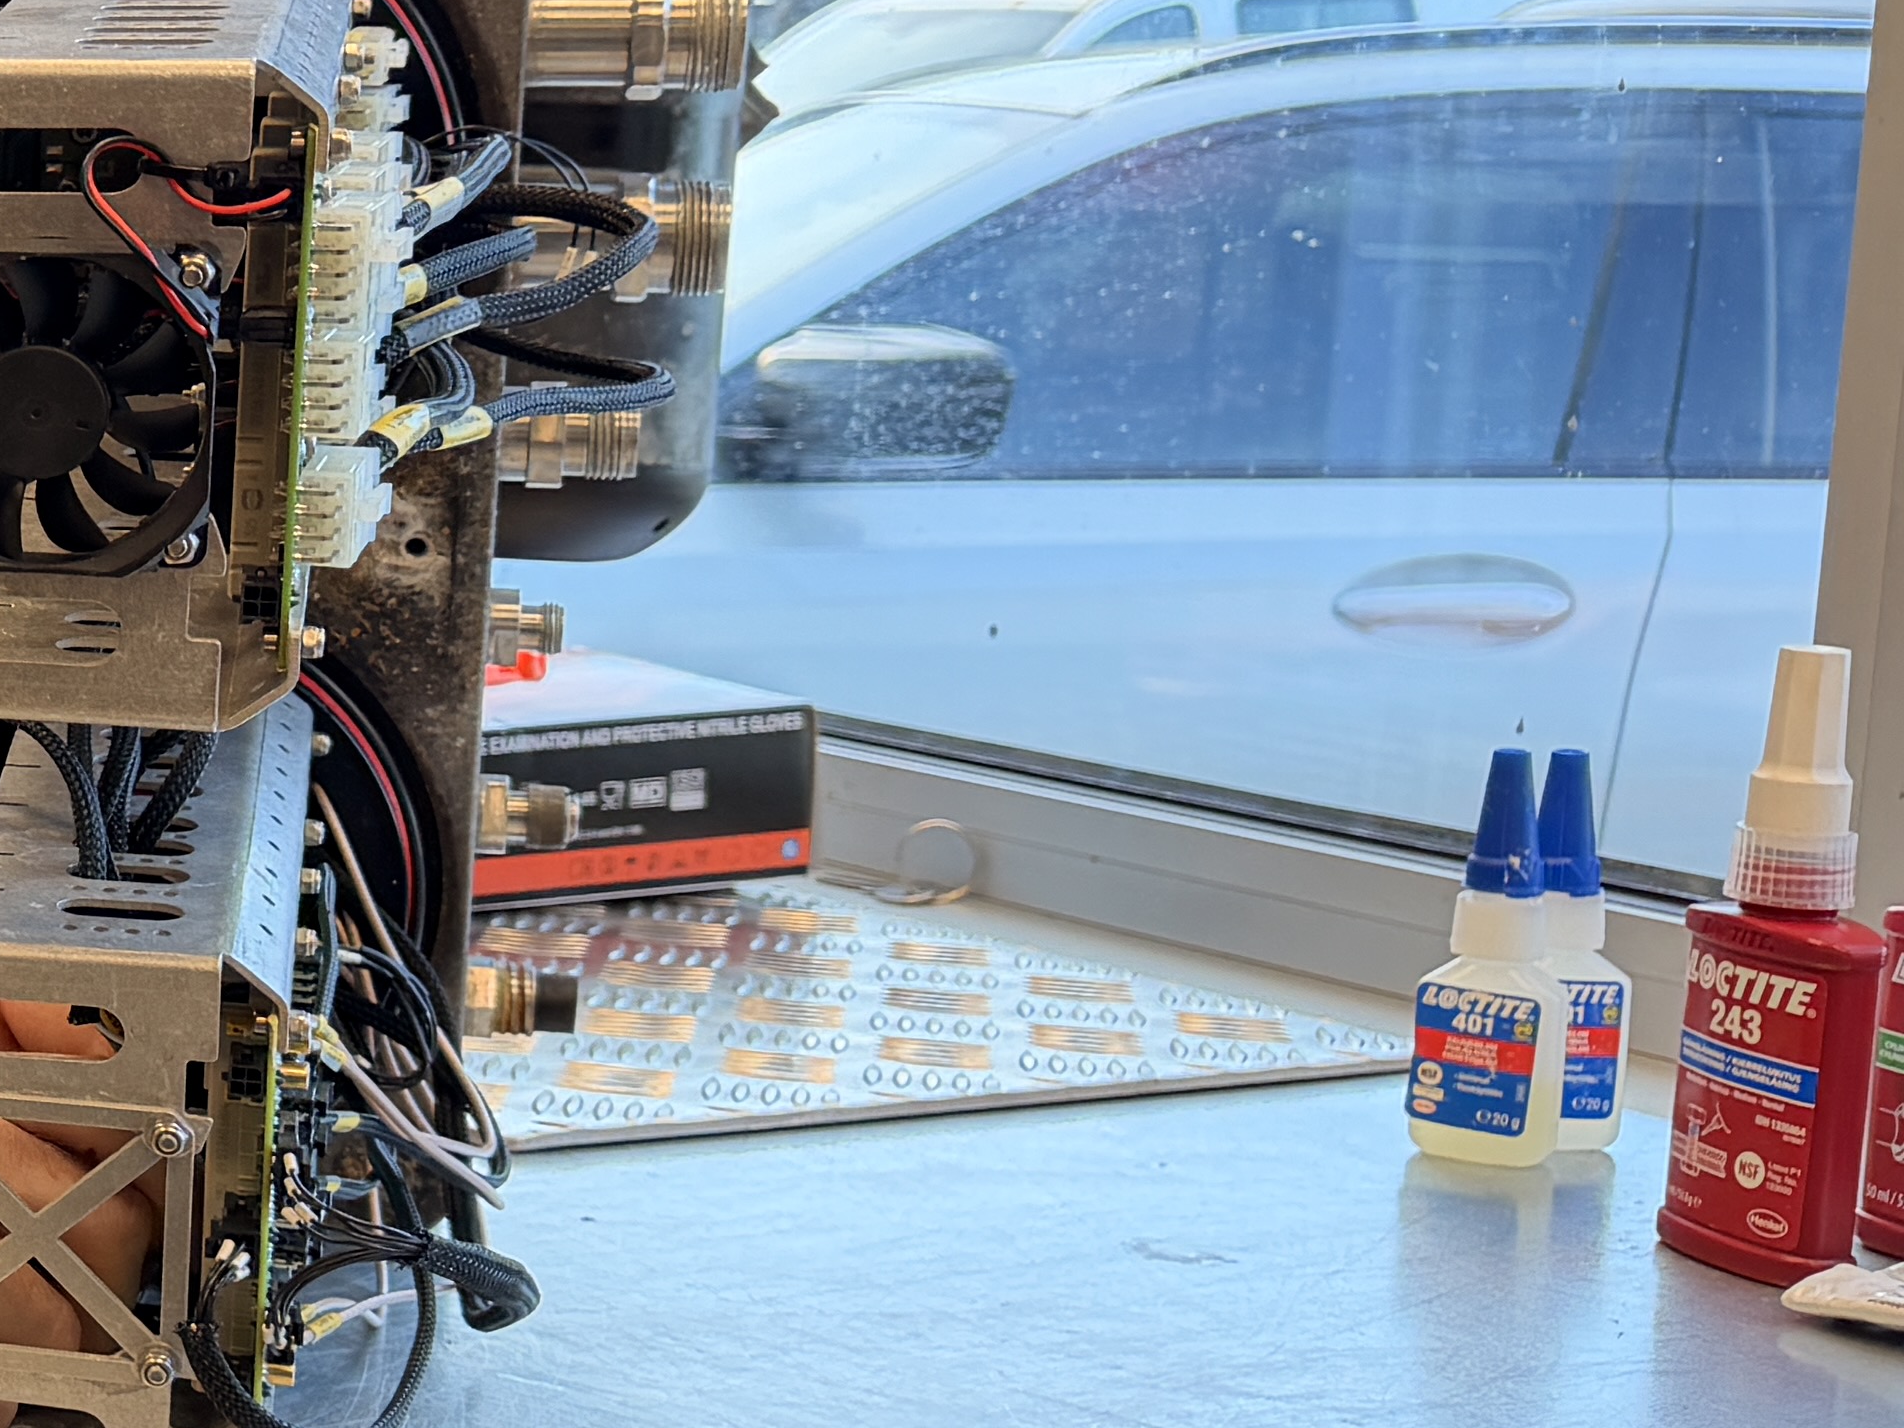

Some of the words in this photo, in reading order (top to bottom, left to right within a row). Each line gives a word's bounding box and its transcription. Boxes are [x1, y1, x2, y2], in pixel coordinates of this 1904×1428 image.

[1452, 1012, 1494, 1036] 401
[1709, 997, 1763, 1045] 243
[1492, 1110, 1509, 1127] 20
[1510, 1116, 1521, 1131] g
[1737, 1158, 1762, 1180] NSF
